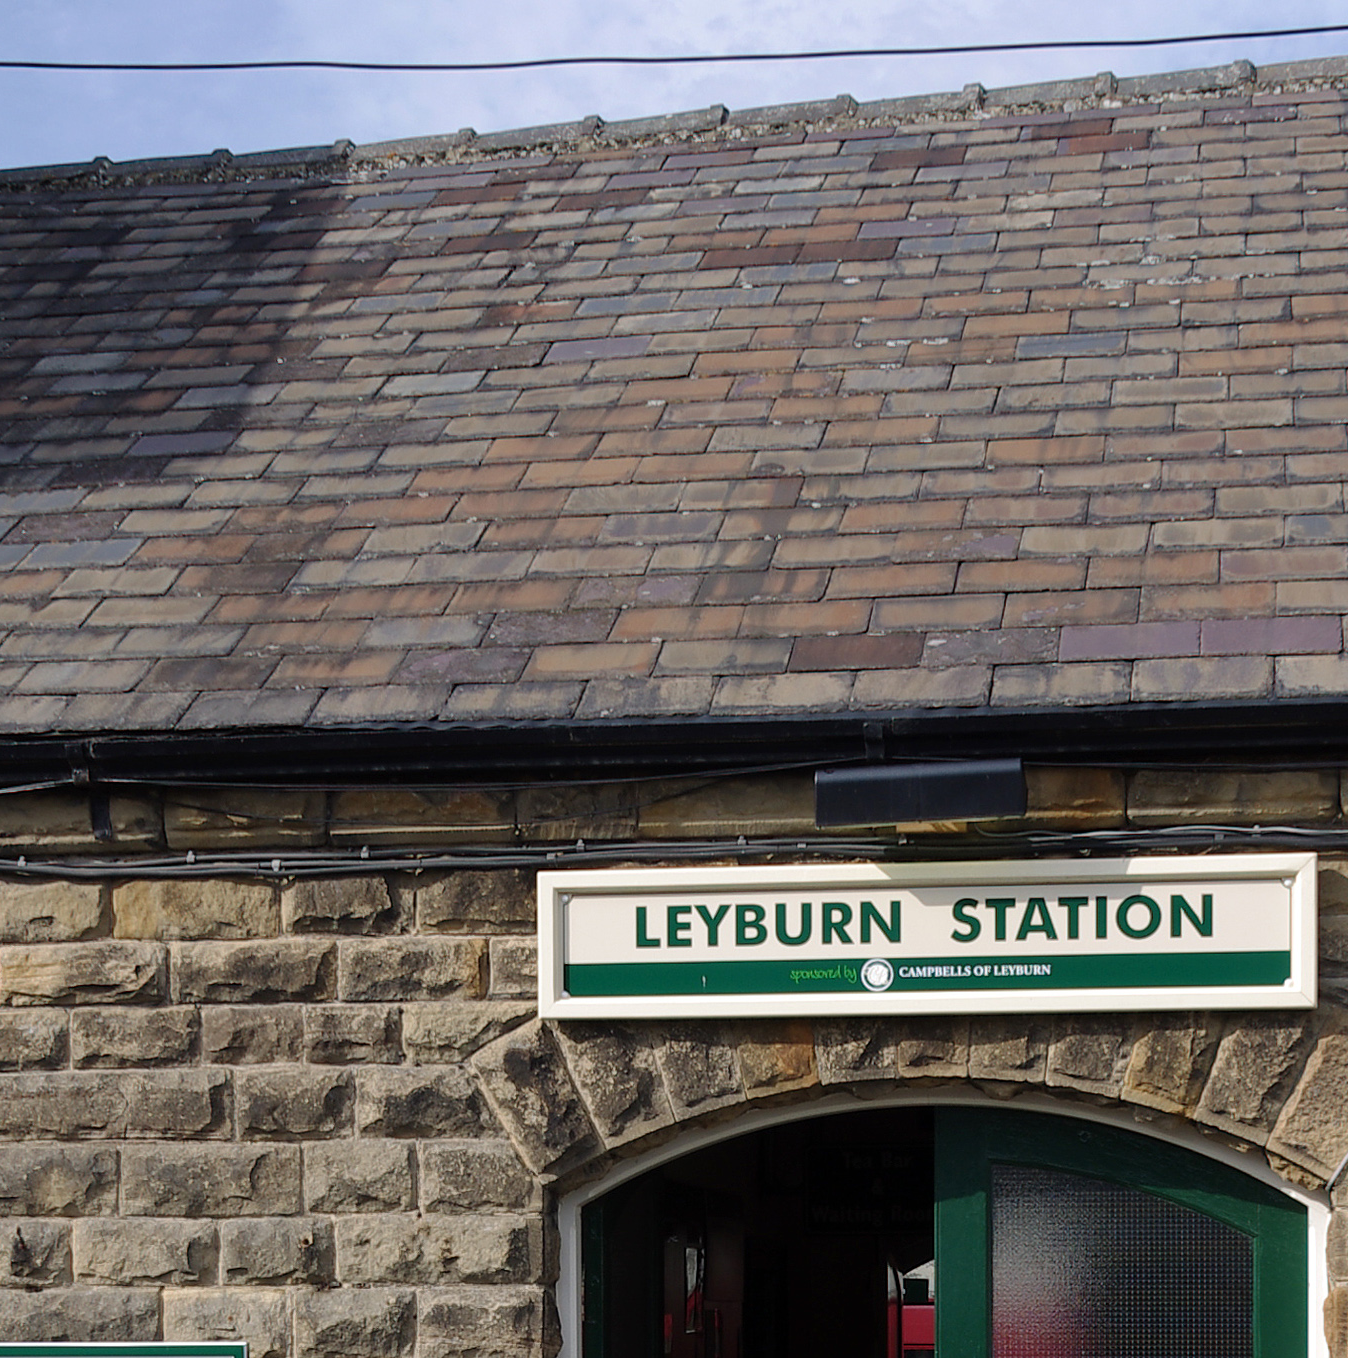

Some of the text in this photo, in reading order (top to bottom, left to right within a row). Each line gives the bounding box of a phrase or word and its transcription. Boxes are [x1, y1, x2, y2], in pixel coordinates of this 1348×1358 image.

[635, 894, 1214, 948] LEYBURN STATION
[790, 964, 1051, 983] sponsored by CAMPBELLS OF LEYBURN
